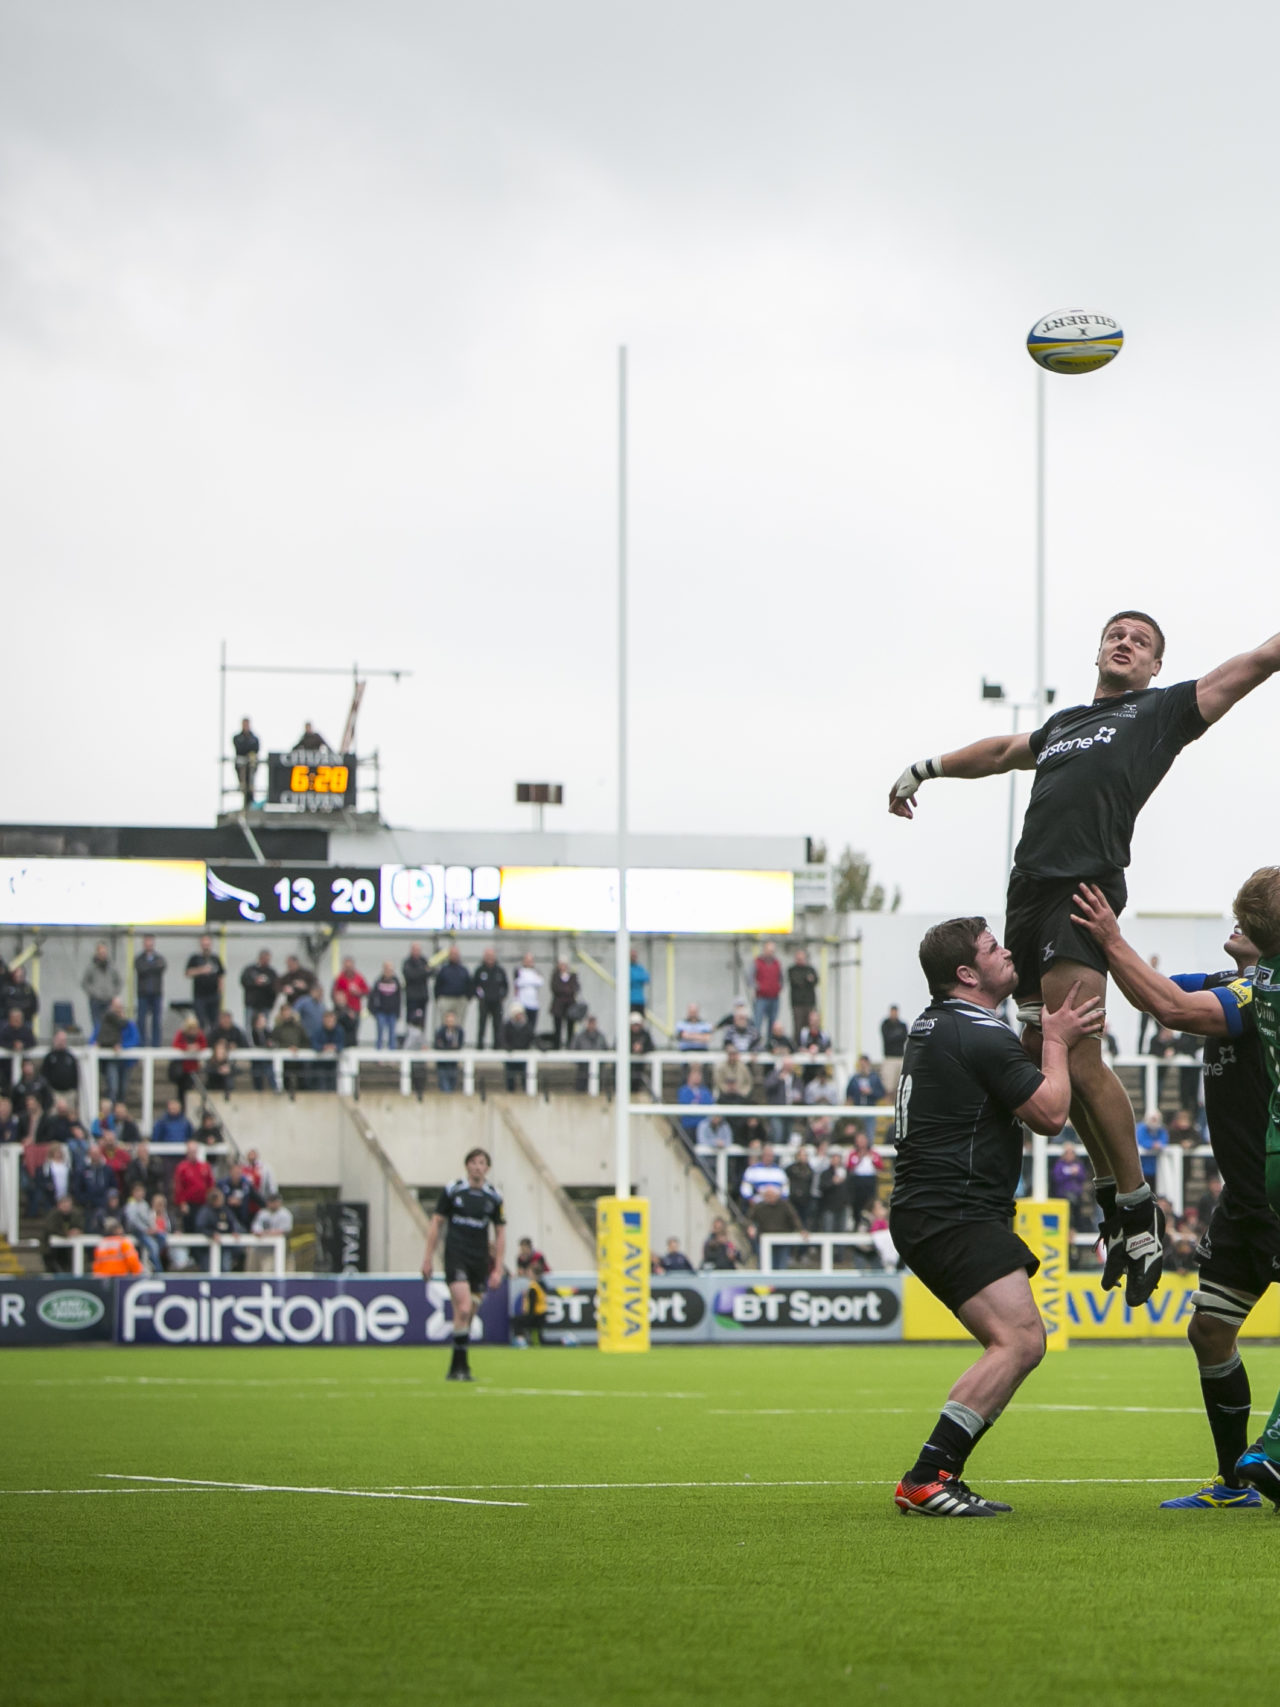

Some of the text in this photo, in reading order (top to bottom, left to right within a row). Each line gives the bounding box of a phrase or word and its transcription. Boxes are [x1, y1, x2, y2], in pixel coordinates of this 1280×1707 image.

[1042, 314, 1117, 334] GILBERT
[290, 765, 349, 793] 6:20
[274, 877, 375, 913] 13 20
[623, 1241, 643, 1338] AVIVA
[1041, 1243, 1060, 1335] AVIVA
[123, 1280, 409, 1343] Fairstone
[733, 1291, 882, 1328] BT Sport
